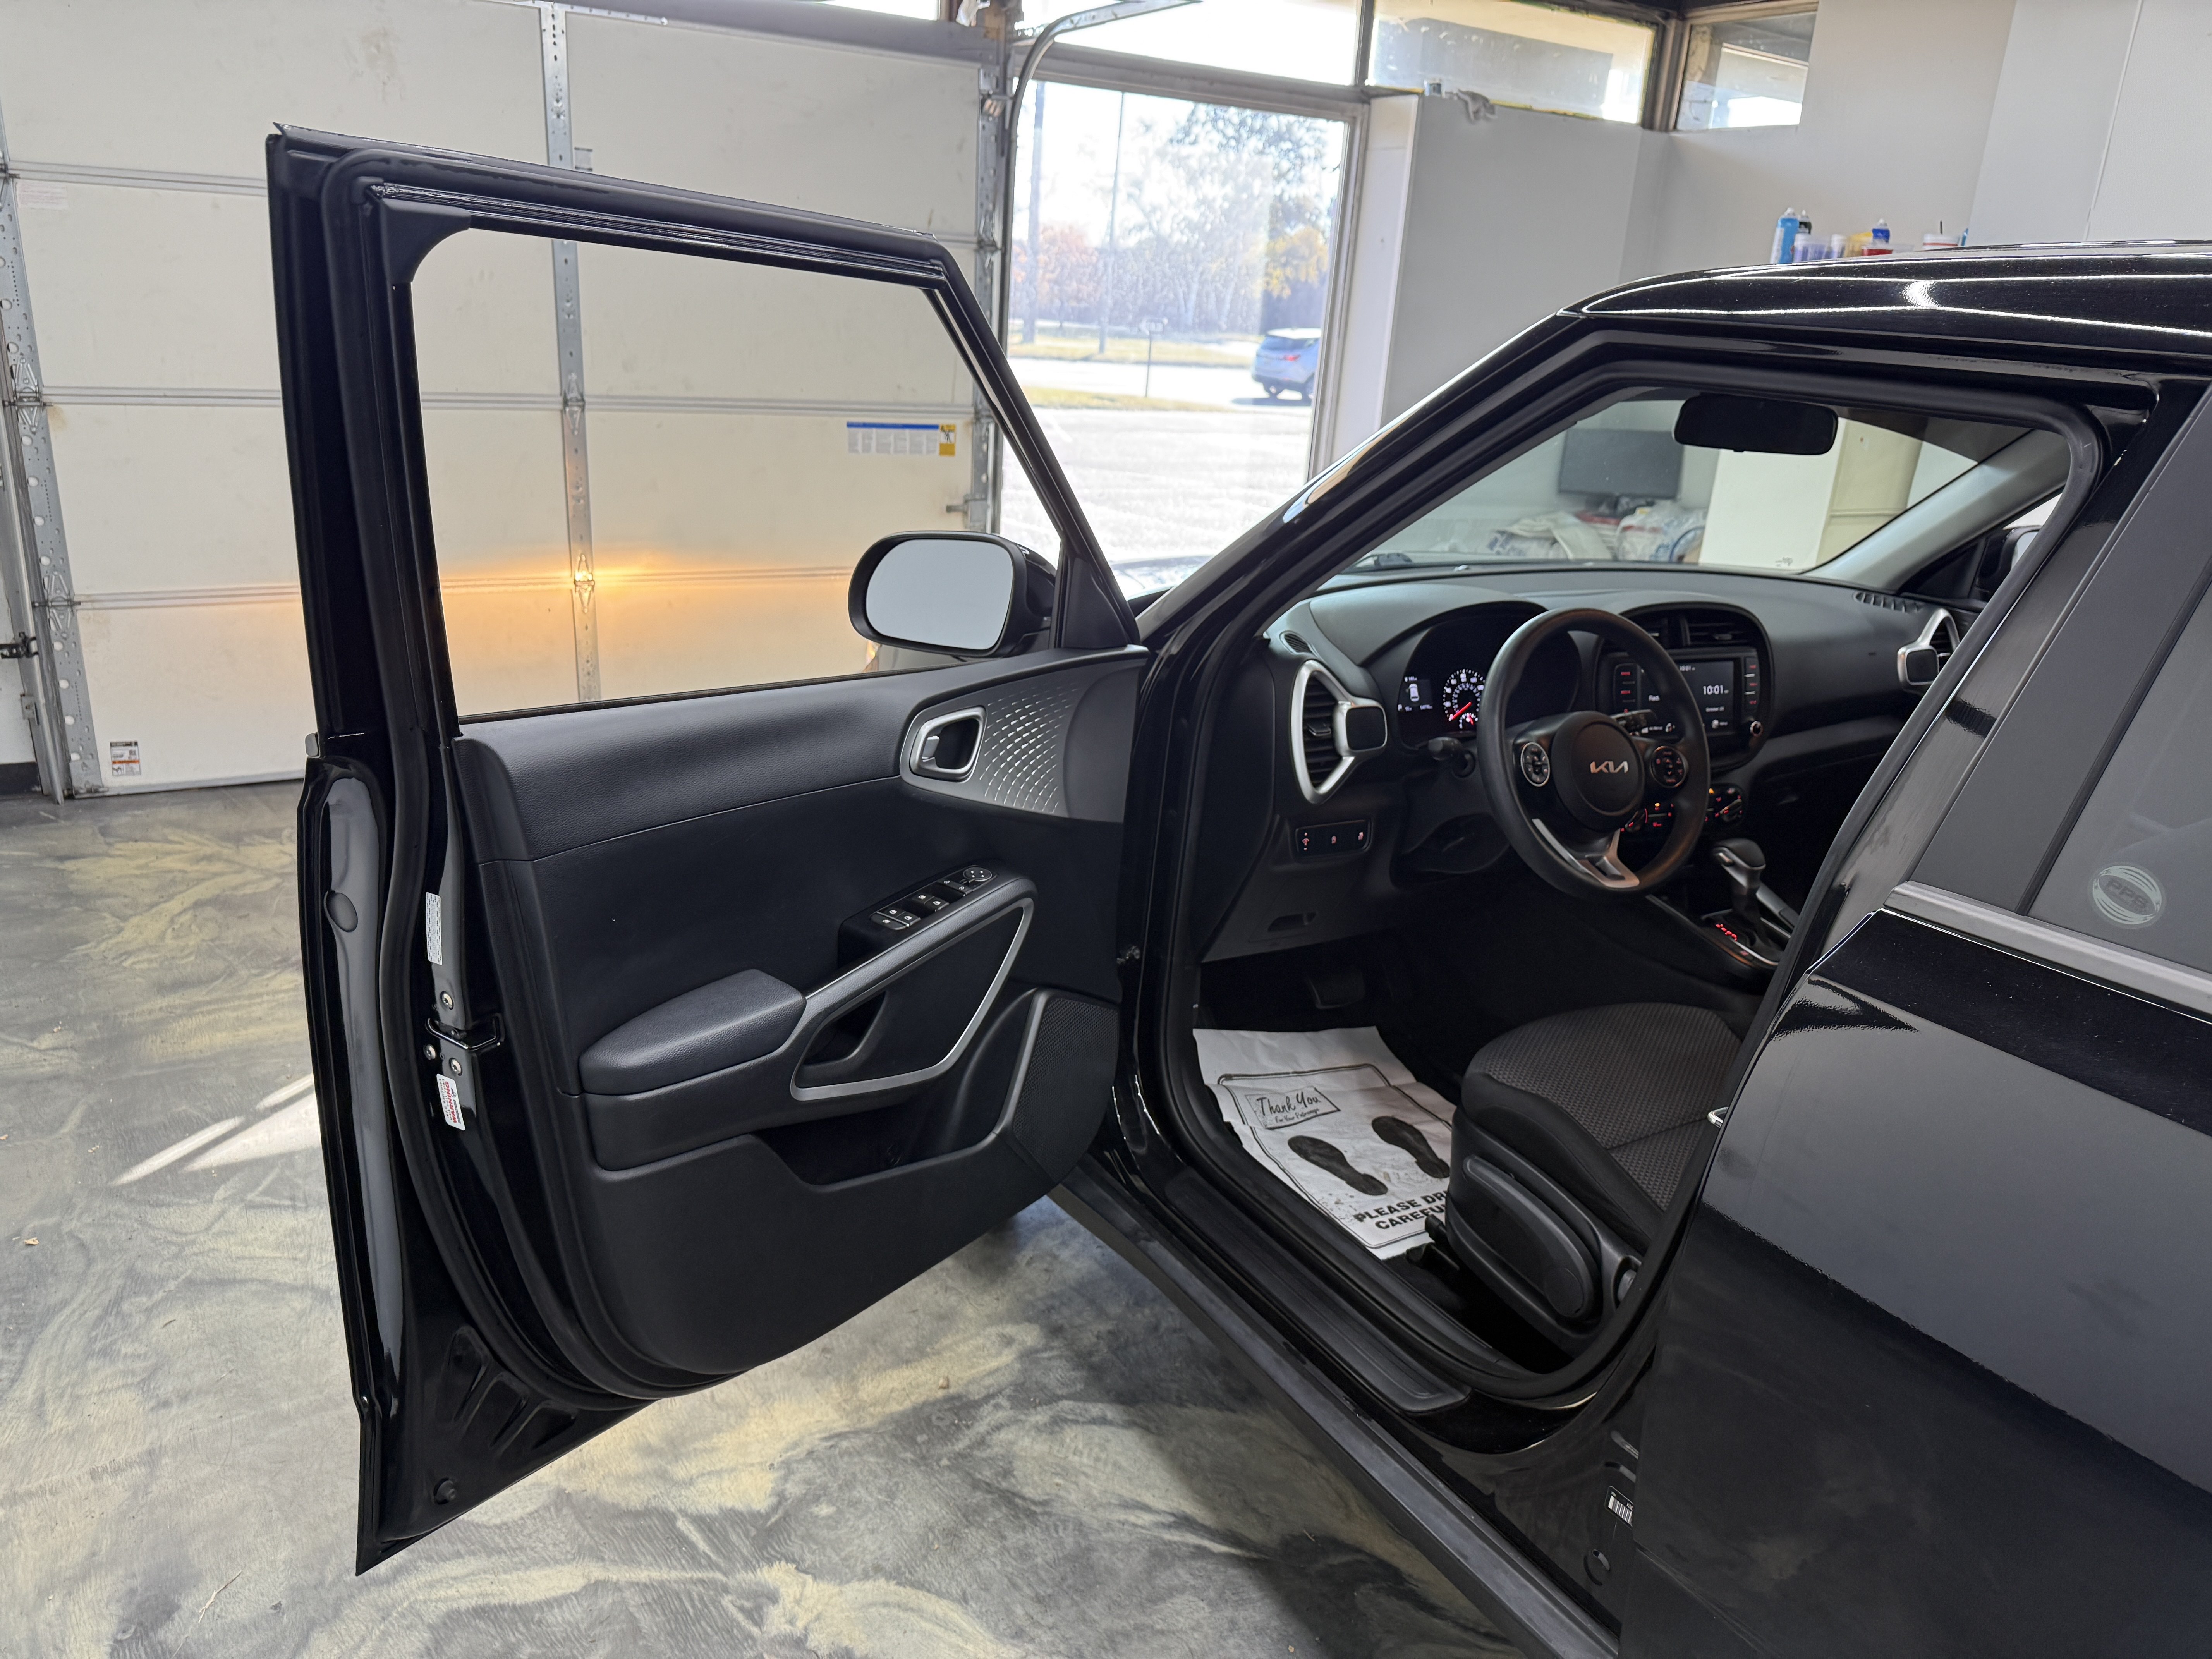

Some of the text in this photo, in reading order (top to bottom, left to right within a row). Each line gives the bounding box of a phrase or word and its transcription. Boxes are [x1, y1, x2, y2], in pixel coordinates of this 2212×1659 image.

[1703, 685, 1723, 696] 10:01
[445, 1081, 457, 1123] WARNING
[1257, 1091, 1321, 1116] Thank You
[1353, 1199, 1422, 1222] PLEASE
[1375, 1204, 1446, 1229] CAREFU
